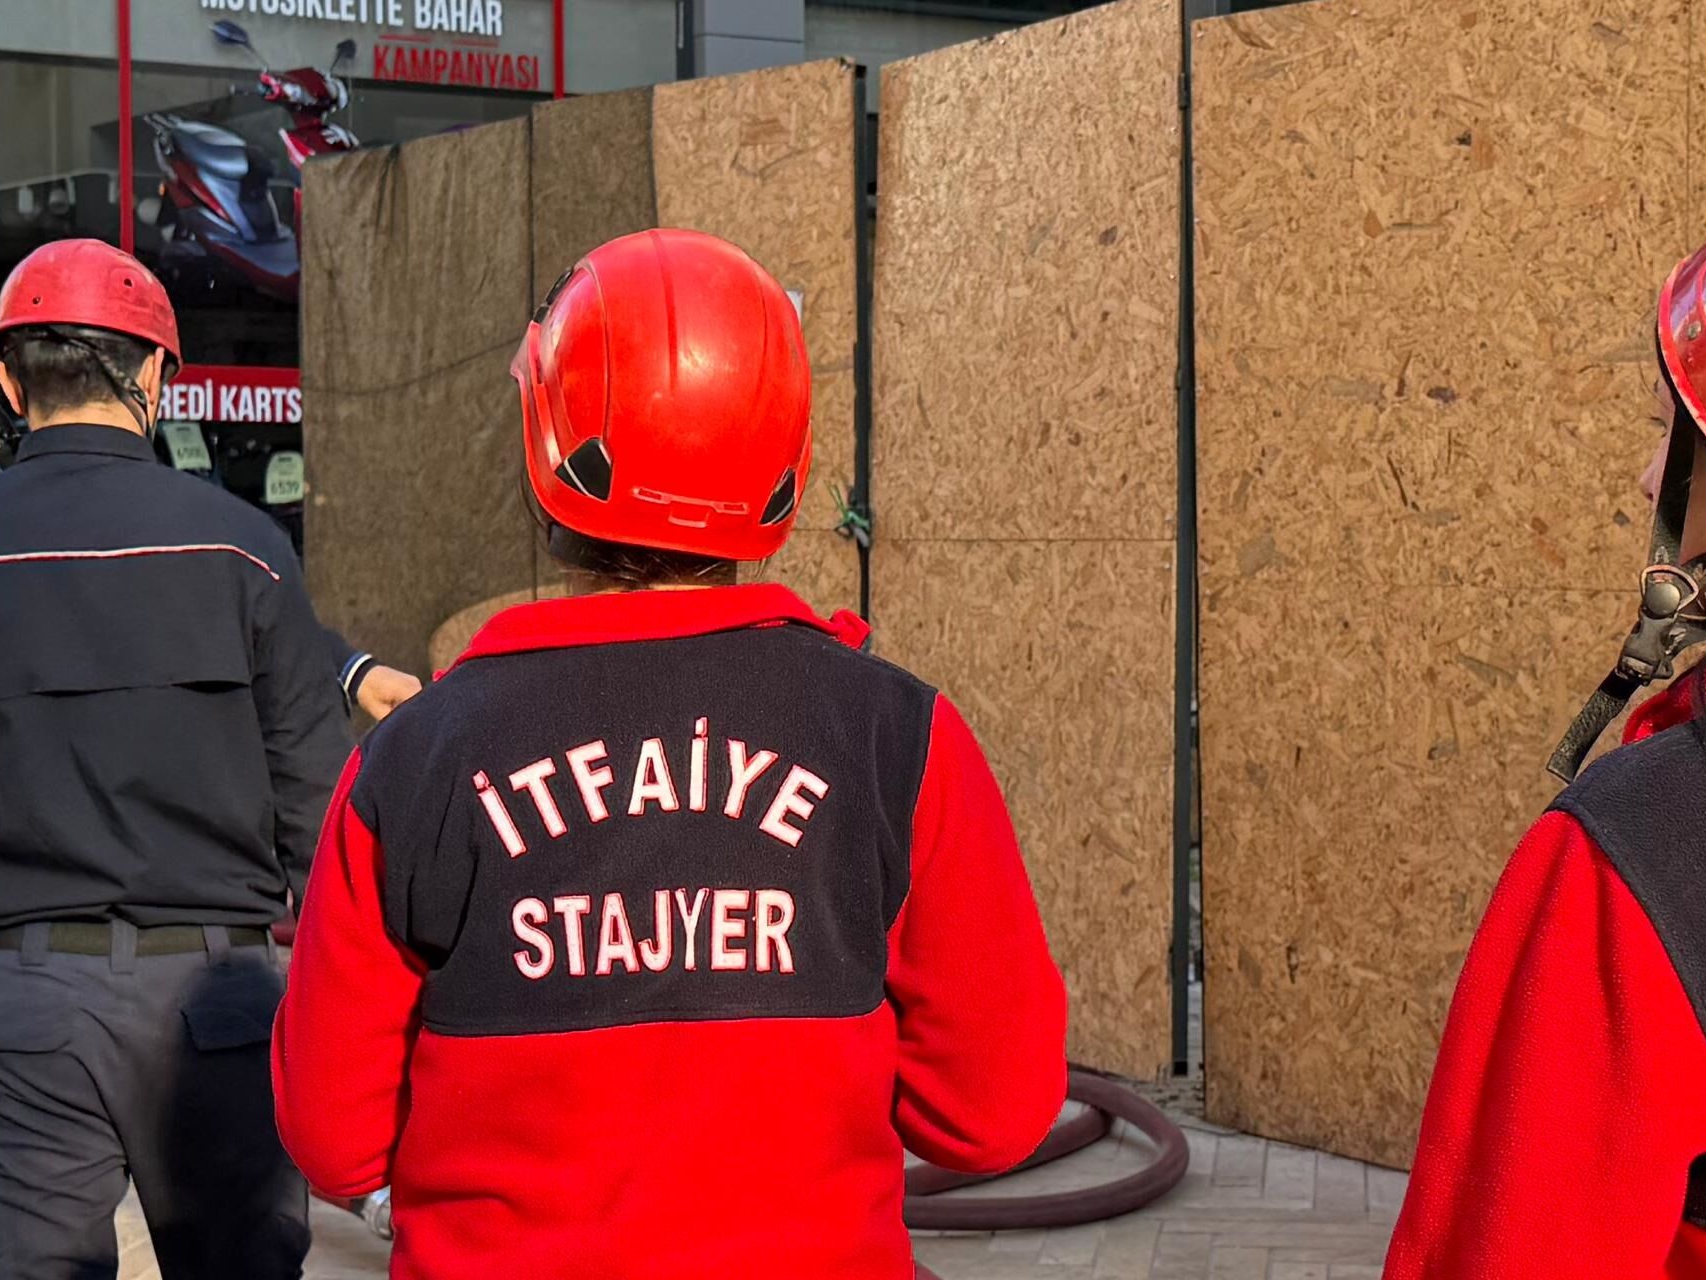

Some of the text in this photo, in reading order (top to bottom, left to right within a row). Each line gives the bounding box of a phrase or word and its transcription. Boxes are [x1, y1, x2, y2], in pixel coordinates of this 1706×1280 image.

[372, 42, 539, 91] KAMPANYASI
[473, 716, 830, 859] İTFAİYE
[512, 886, 795, 981] STAJYER
